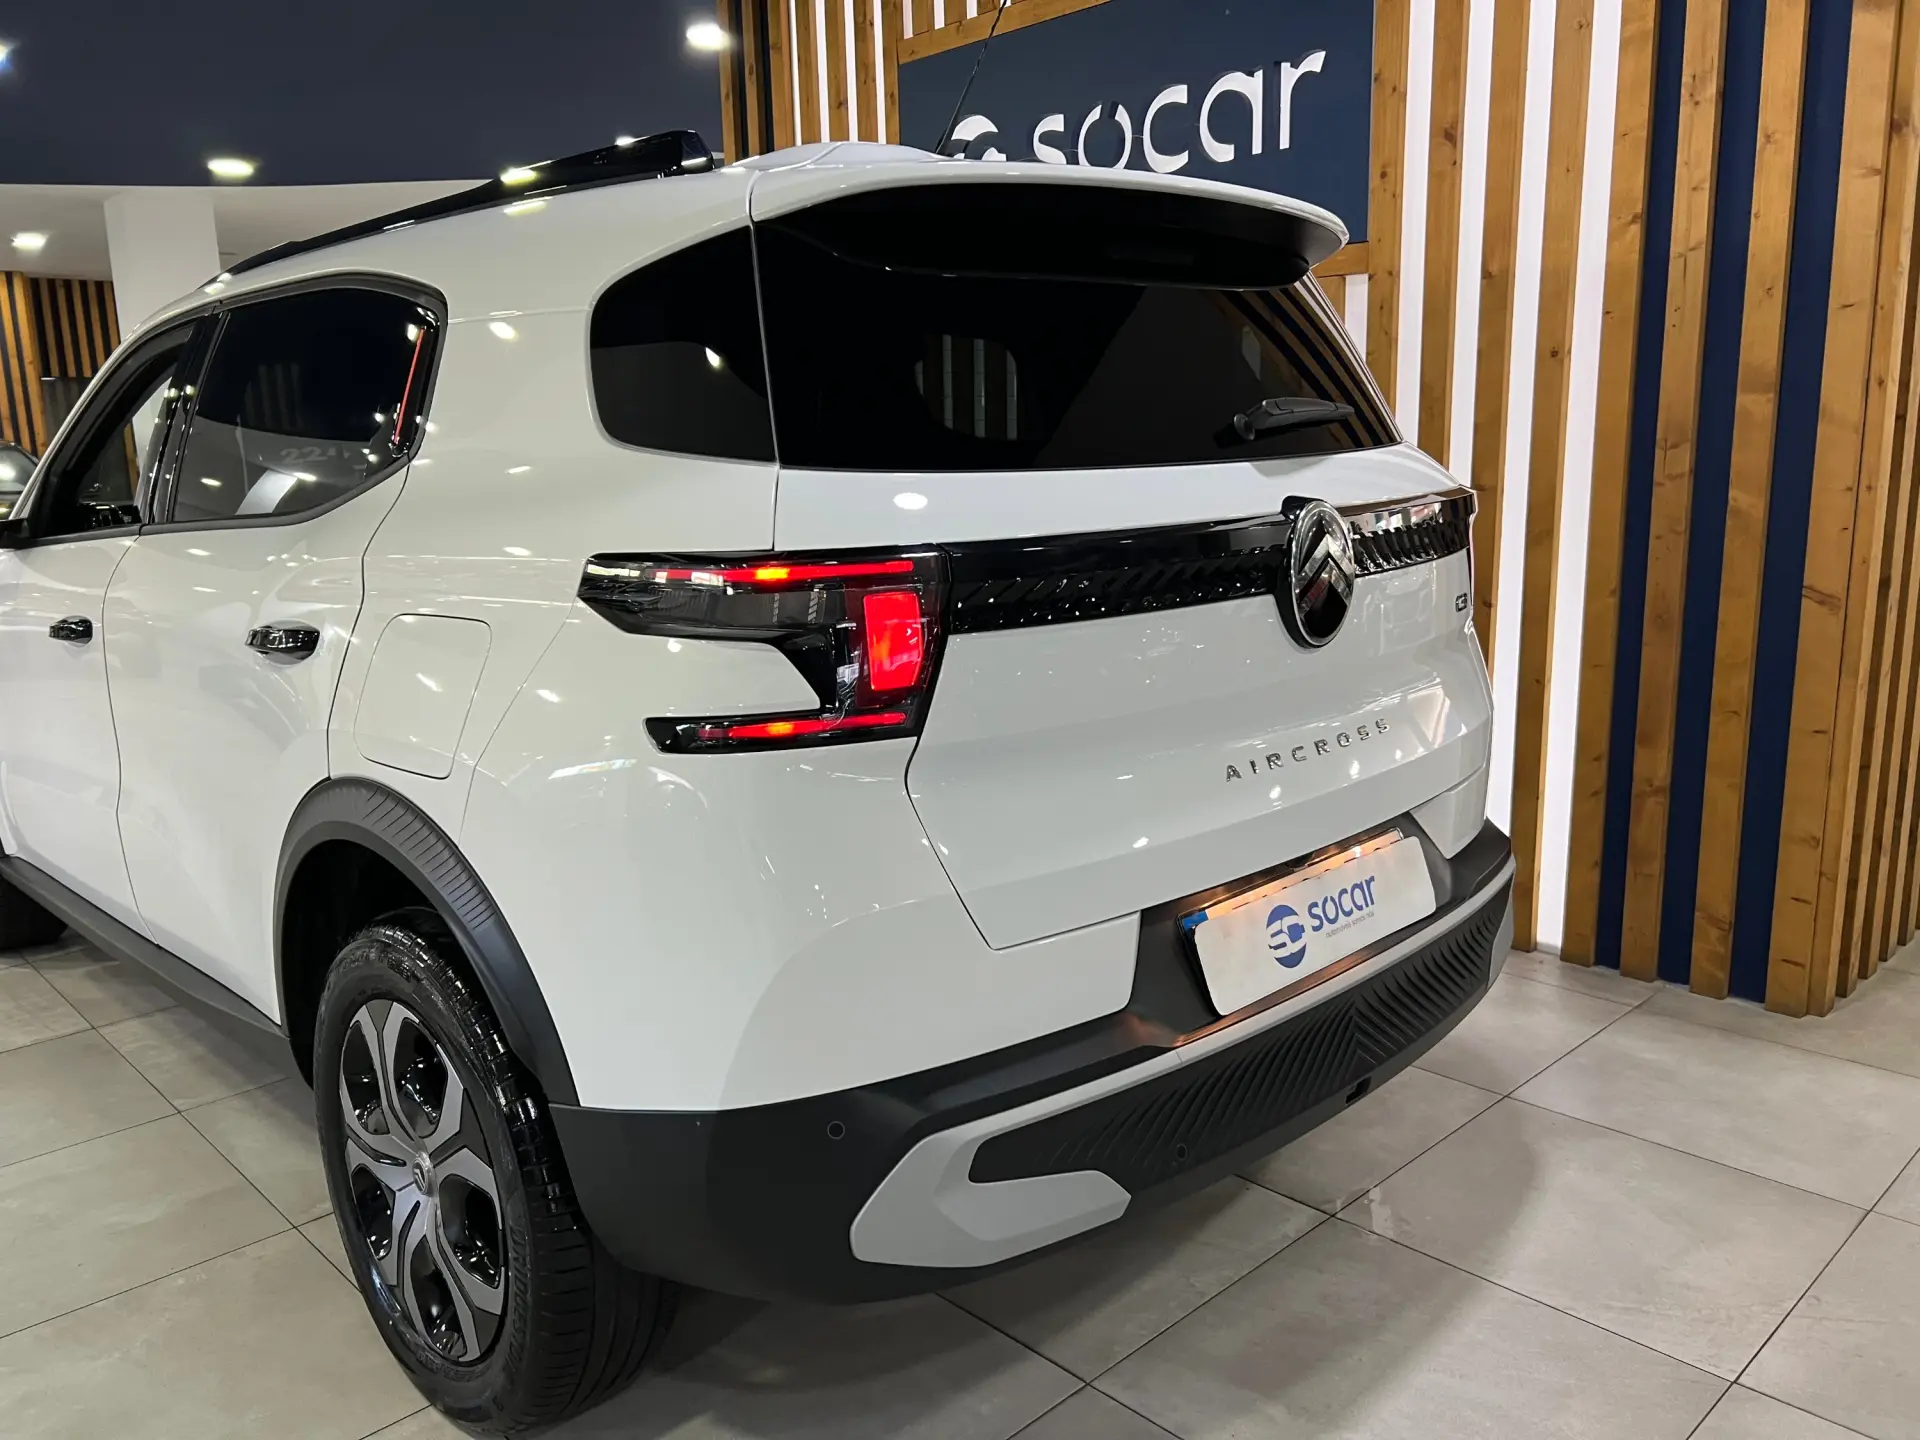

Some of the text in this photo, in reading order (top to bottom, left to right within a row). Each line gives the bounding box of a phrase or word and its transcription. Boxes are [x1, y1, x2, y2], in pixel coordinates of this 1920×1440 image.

[1032, 50, 1326, 173] socar
[1226, 718, 1391, 782] AIRCROSS
[1307, 875, 1375, 932] socar
